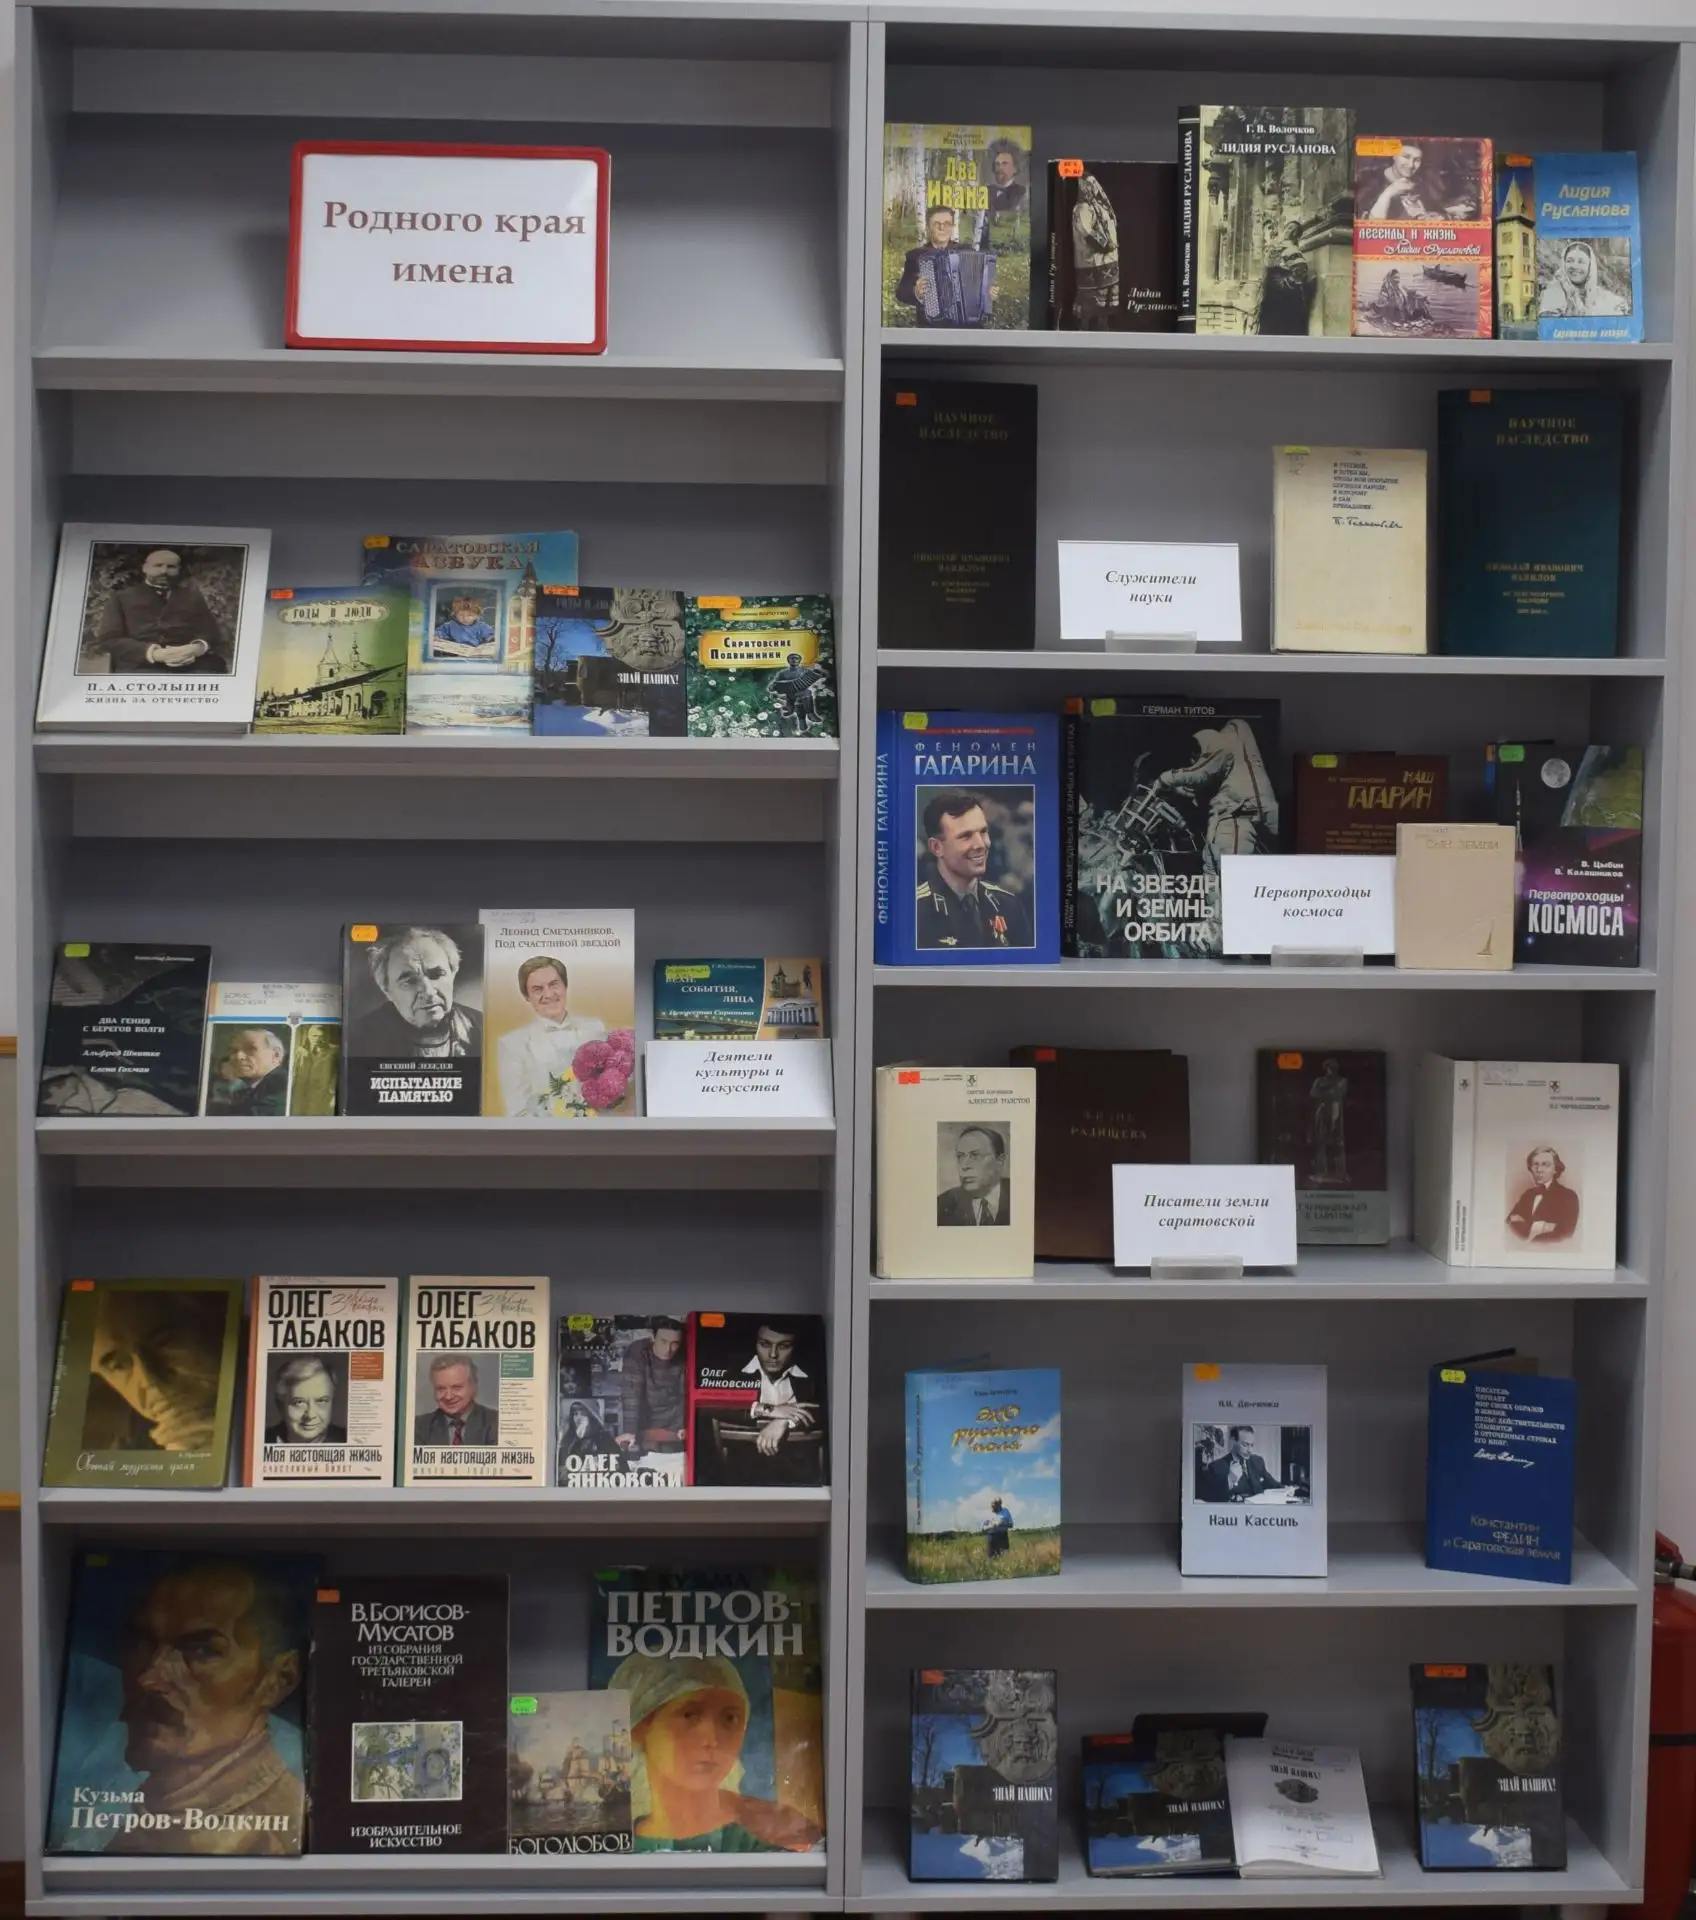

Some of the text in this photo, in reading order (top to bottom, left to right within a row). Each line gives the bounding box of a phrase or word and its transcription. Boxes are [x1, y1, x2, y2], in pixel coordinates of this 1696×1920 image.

[1269, 124, 1316, 135] Волочков
[1218, 142, 1337, 156] ЛИДИЯ РУСЛАНОВА
[945, 157, 977, 182] Два
[1183, 130, 1193, 197] РУСЛАНОВА
[927, 180, 989, 210] Ивана
[1558, 183, 1612, 201] Лидия
[1183, 198, 1193, 238] ЛИДИЯ
[1541, 202, 1631, 221] Русланова
[323, 201, 586, 243] Родного края
[1423, 228, 1458, 241] ЖИЗНЬ
[1182, 242, 1192, 287] Волочков
[392, 262, 515, 285] имена
[1127, 287, 1162, 299] Лидия
[396, 539, 540, 556] САРАТОВСКАЯ
[413, 555, 526, 571] АЗБУКА
[1105, 568, 1199, 587] Служители
[1129, 591, 1174, 607] науки
[617, 672, 641, 685] ЗНАЙ
[126, 682, 220, 692] СТОЛЫПИН
[131, 697, 148, 705] ЗА
[152, 697, 220, 705] ОТЕЧЕСТВО
[1142, 706, 1216, 715] ГЕРМАН ТИТОВ
[915, 741, 1036, 753] ФЕНОМЕН
[914, 754, 1038, 776] ГАГАРИНА
[1347, 785, 1433, 809] ГАГАРИН
[877, 753, 889, 925] ФЕНОМЕН ГАГАРИНА
[1096, 874, 1220, 899] НА ЗВЕЗДН
[1253, 885, 1372, 901] Первопроходцы
[1528, 889, 1625, 904] Первопроходцы
[1116, 898, 1220, 918] И ЗЕМНЫ
[1282, 906, 1344, 918] космоса
[1527, 903, 1625, 937] КОСМОСА
[1124, 921, 1213, 942] ОРБИТА
[681, 984, 738, 994] СОБЫТИЯ,
[722, 995, 755, 1003] ЛИЦА
[703, 1051, 773, 1063] Деятели
[695, 1068, 784, 1080] культуры и
[370, 1077, 463, 1090] ИСПЫТАНИЕ
[701, 1084, 780, 1095] искусства
[378, 1090, 453, 1103] ПАМЯТЬЮ
[1143, 1193, 1270, 1208] Писатели земли
[1158, 1214, 1256, 1230] саратовской
[268, 1289, 332, 1319] ОЛЕГ
[417, 1290, 482, 1319] ОЛЕГ
[268, 1319, 386, 1348] ТАБАКОВ
[416, 1320, 537, 1349] ТАБАКОВ
[701, 1367, 728, 1377] ОЛЕГ
[700, 1377, 761, 1389] ЯНКОВСКИЙ
[263, 1446, 383, 1464] Моя настоящая жизнь
[412, 1447, 536, 1465] Моя настоящая жизнь
[565, 1453, 620, 1472] ОЛЕГ
[567, 1472, 681, 1488] ЯНКОВСКИ
[1208, 1514, 1299, 1528] Наш Кассиль
[606, 1590, 802, 1624] ПЕТРОВ-
[357, 1623, 455, 1642] МУСАТОВ
[368, 1644, 443, 1655] ИЗ СОБРАНИЯ
[606, 1623, 805, 1660] ВОДКИН
[351, 1654, 464, 1667] ГОСУДАРСТВЕННОЙ
[361, 1665, 456, 1677] ТРЕТЬЯКОВСКОЙ
[382, 1677, 432, 1688] ГАЛЕРЕИ
[73, 1786, 146, 1807] Кузьма
[69, 1806, 291, 1834] Петров-Водкин
[351, 1823, 463, 1839] ИЗОБРАЗИТЕЛЬНОЕ
[369, 1836, 443, 1849] ИСКУССТВО
[508, 1832, 631, 1856] БОГОЛЮБОВ
